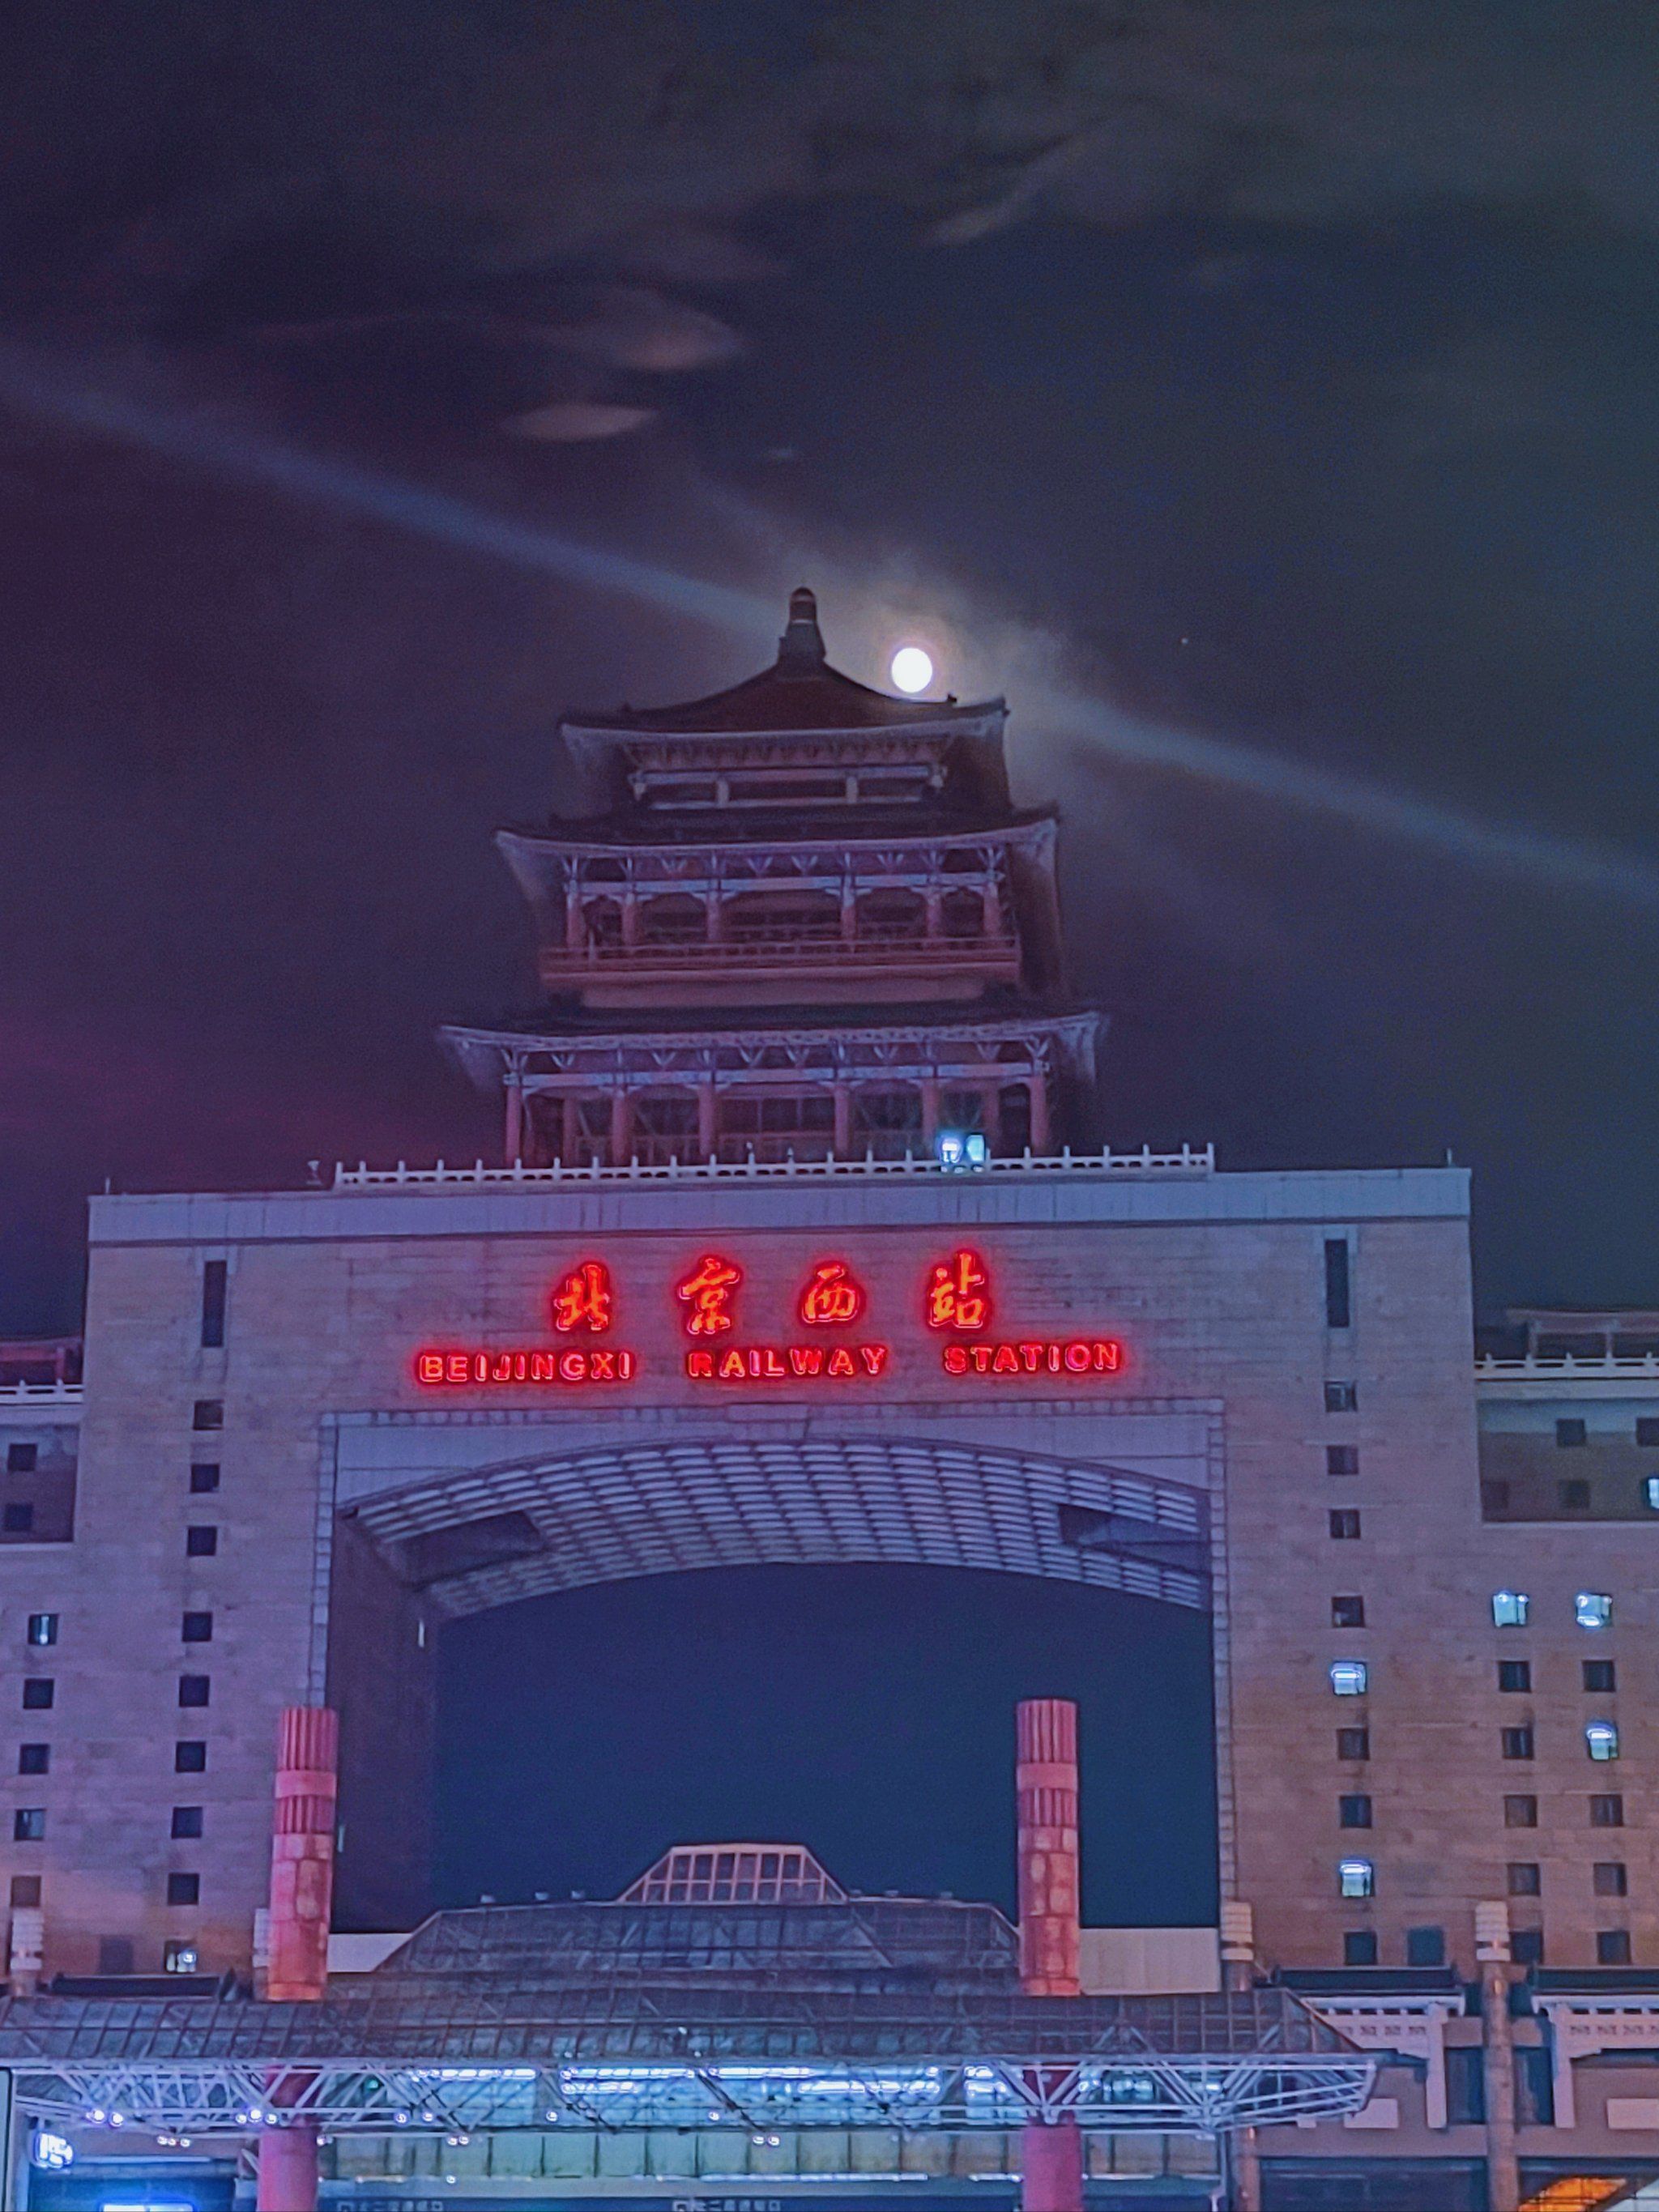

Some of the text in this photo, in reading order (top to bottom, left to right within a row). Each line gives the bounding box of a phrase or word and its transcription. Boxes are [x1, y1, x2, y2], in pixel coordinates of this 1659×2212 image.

[553, 1252, 986, 1335] 北京西站
[419, 1342, 1120, 1382] BEIJINGXI RAILWAY STATION
